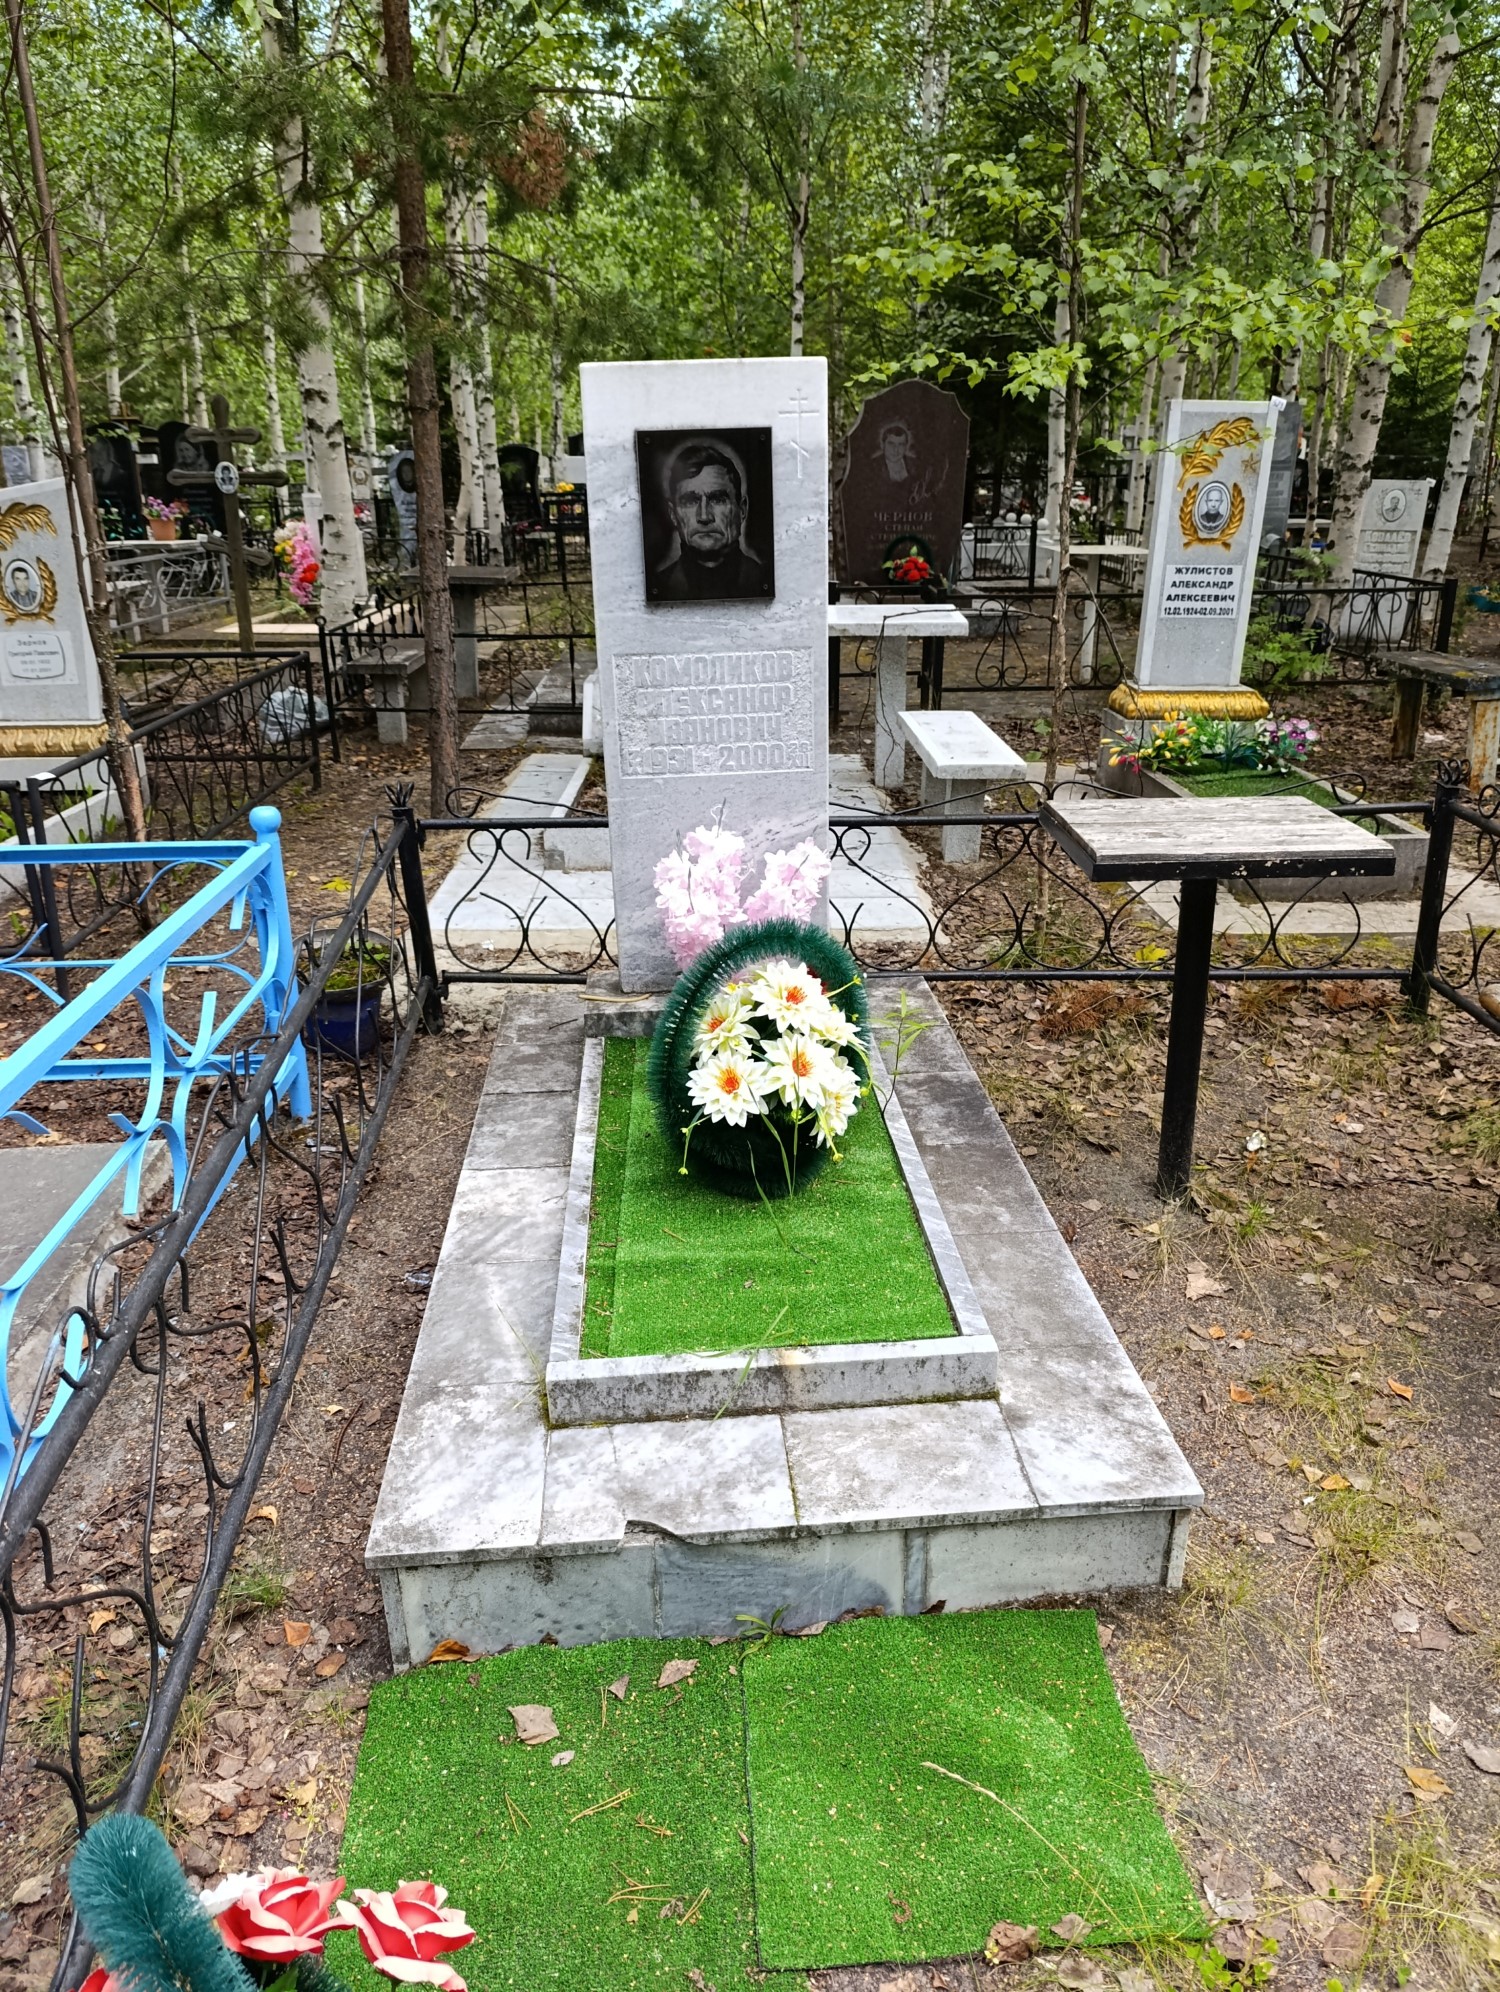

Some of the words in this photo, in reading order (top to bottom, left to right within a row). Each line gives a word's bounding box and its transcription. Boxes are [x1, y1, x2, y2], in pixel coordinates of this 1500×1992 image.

[873, 511, 933, 522] ЧЕРНОВ
[1174, 567, 1233, 576] ЖУЛИСТОВ
[1170, 580, 1234, 590] АЛЕКСАНДР
[1166, 594, 1235, 602] АЛЕКСЕЕВИЧ
[717, 741, 786, 772] 2000
